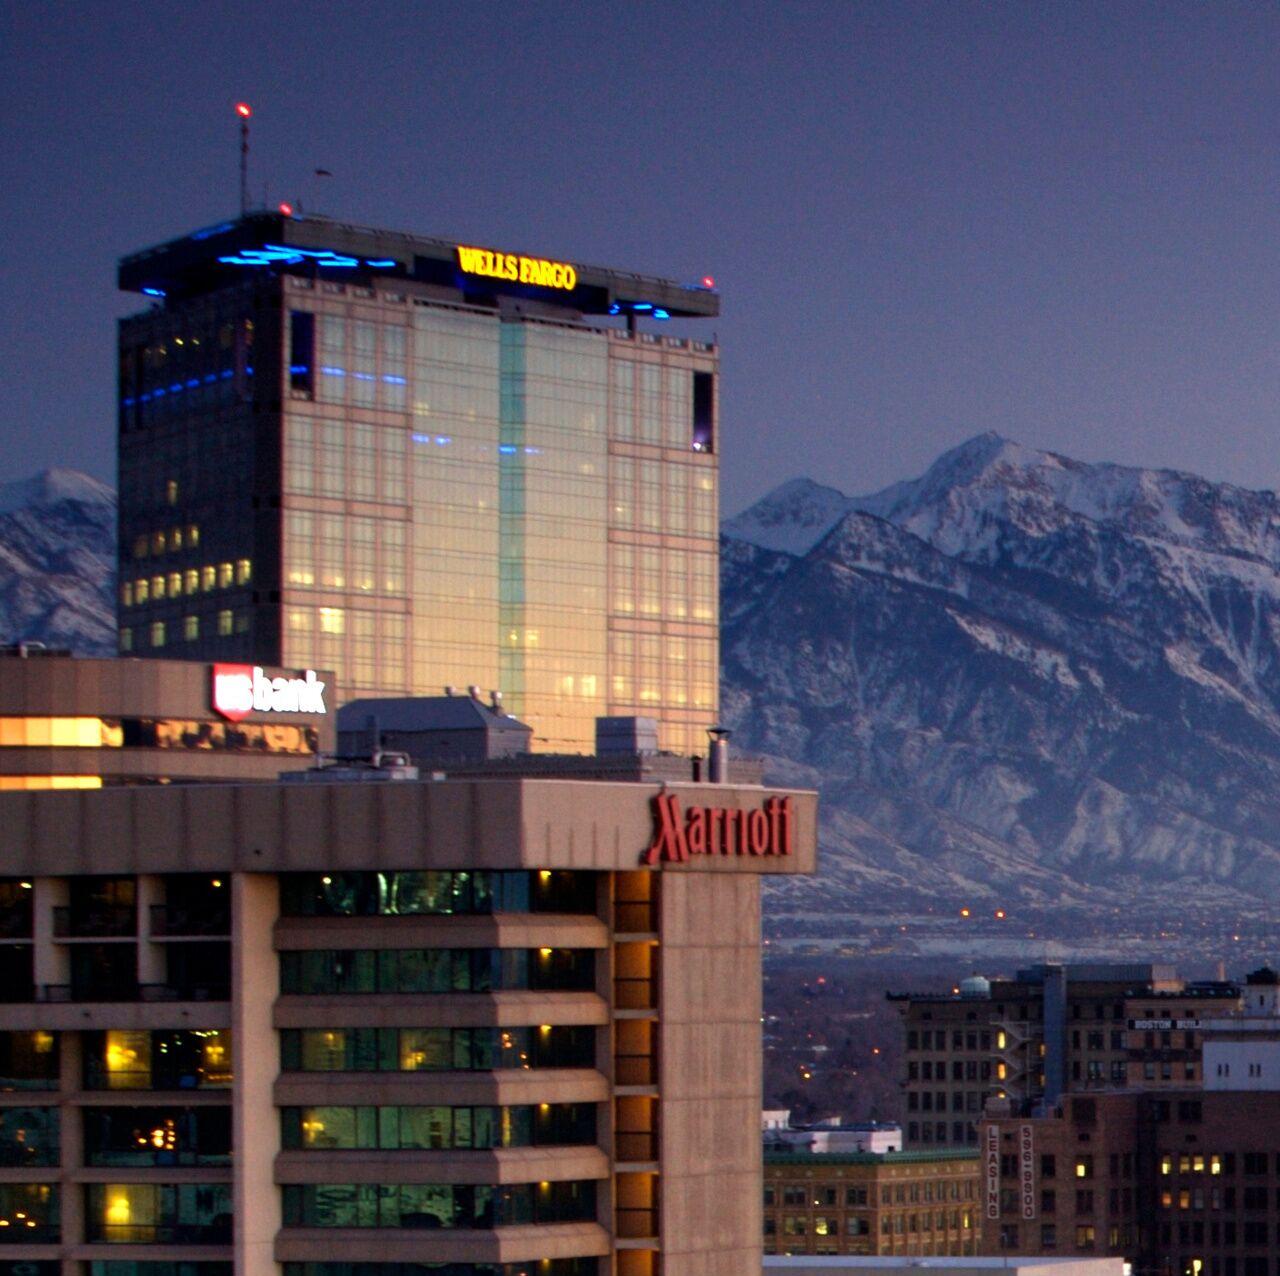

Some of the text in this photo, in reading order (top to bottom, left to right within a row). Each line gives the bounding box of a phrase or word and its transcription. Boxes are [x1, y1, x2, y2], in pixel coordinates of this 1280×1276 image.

[458, 245, 576, 291] WELLS FARGO
[645, 791, 794, 865] Marriott
[1135, 1020, 1171, 1029] BOSTON
[988, 1127, 998, 1217] LEASING
[1022, 1127, 1033, 1217] 596-9900
